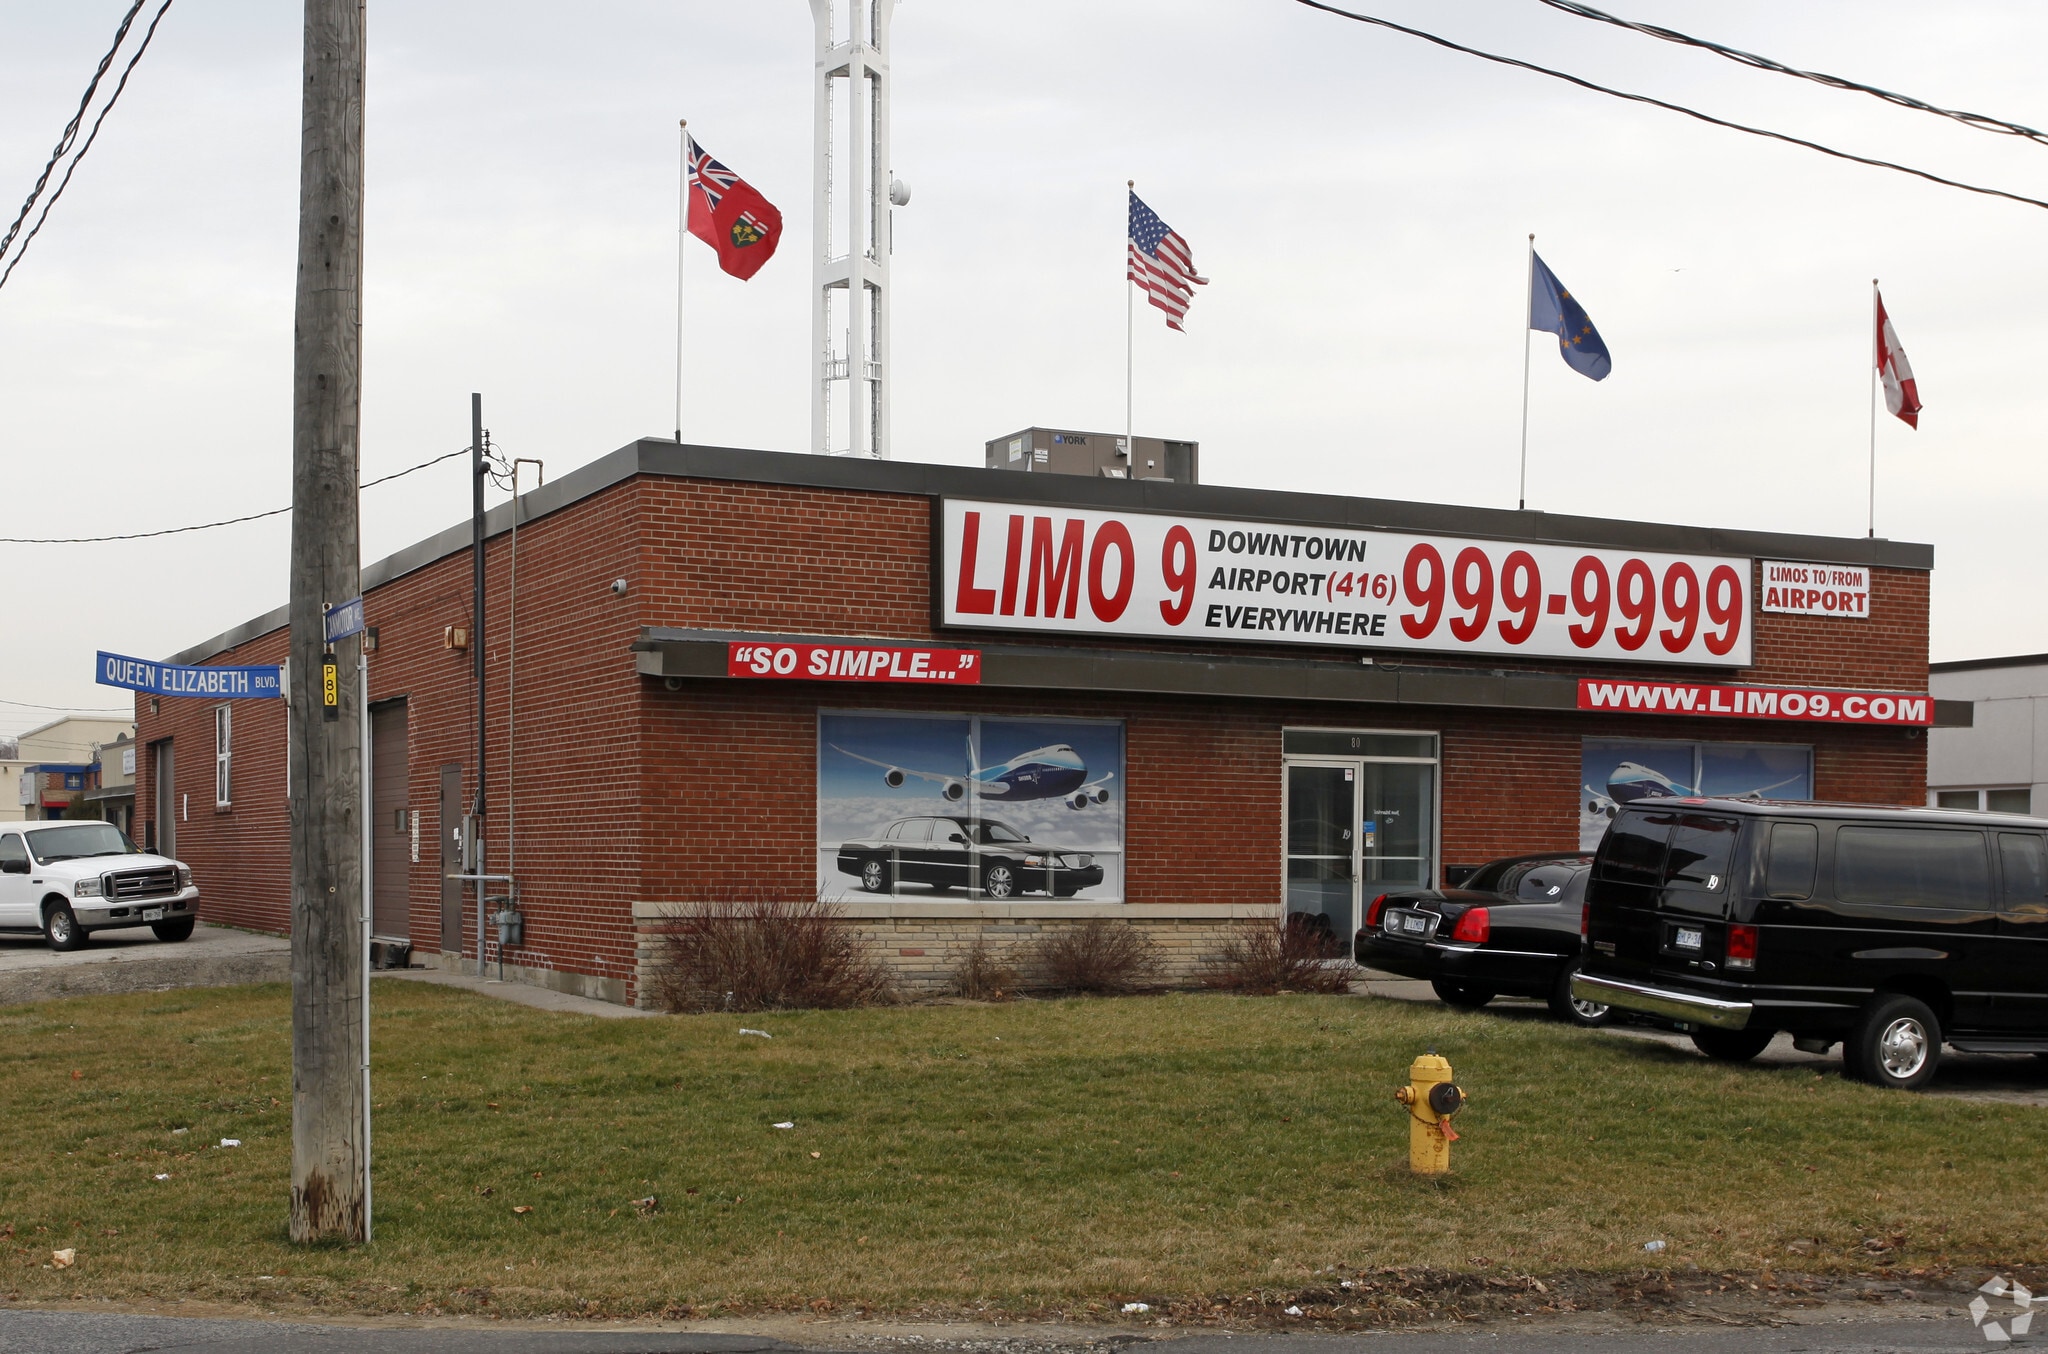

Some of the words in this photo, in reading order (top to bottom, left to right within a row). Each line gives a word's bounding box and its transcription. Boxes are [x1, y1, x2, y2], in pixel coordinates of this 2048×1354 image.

[1062, 435, 1087, 446] YORK
[1208, 529, 1367, 563] DOWNTOWN
[956, 511, 1135, 623] LIMO
[1160, 525, 1197, 627] 9
[1208, 566, 1327, 597] AIRPORT
[1326, 571, 1397, 604] (416)
[1769, 566, 1809, 584] LIMOS
[1812, 569, 1863, 588] TO/FROM
[1400, 543, 1743, 656] 999-9999
[1765, 587, 1867, 612] AIRPORT
[327, 606, 354, 640] CANMOTOR
[1204, 604, 1387, 637] EVERYWHERE
[106, 657, 155, 688] QUEEN
[162, 668, 248, 693] ELIZABETH
[255, 676, 279, 689] BLVD.
[1587, 683, 1926, 722] WWW.LIMO9.COM
[1351, 737, 1361, 748] 80
